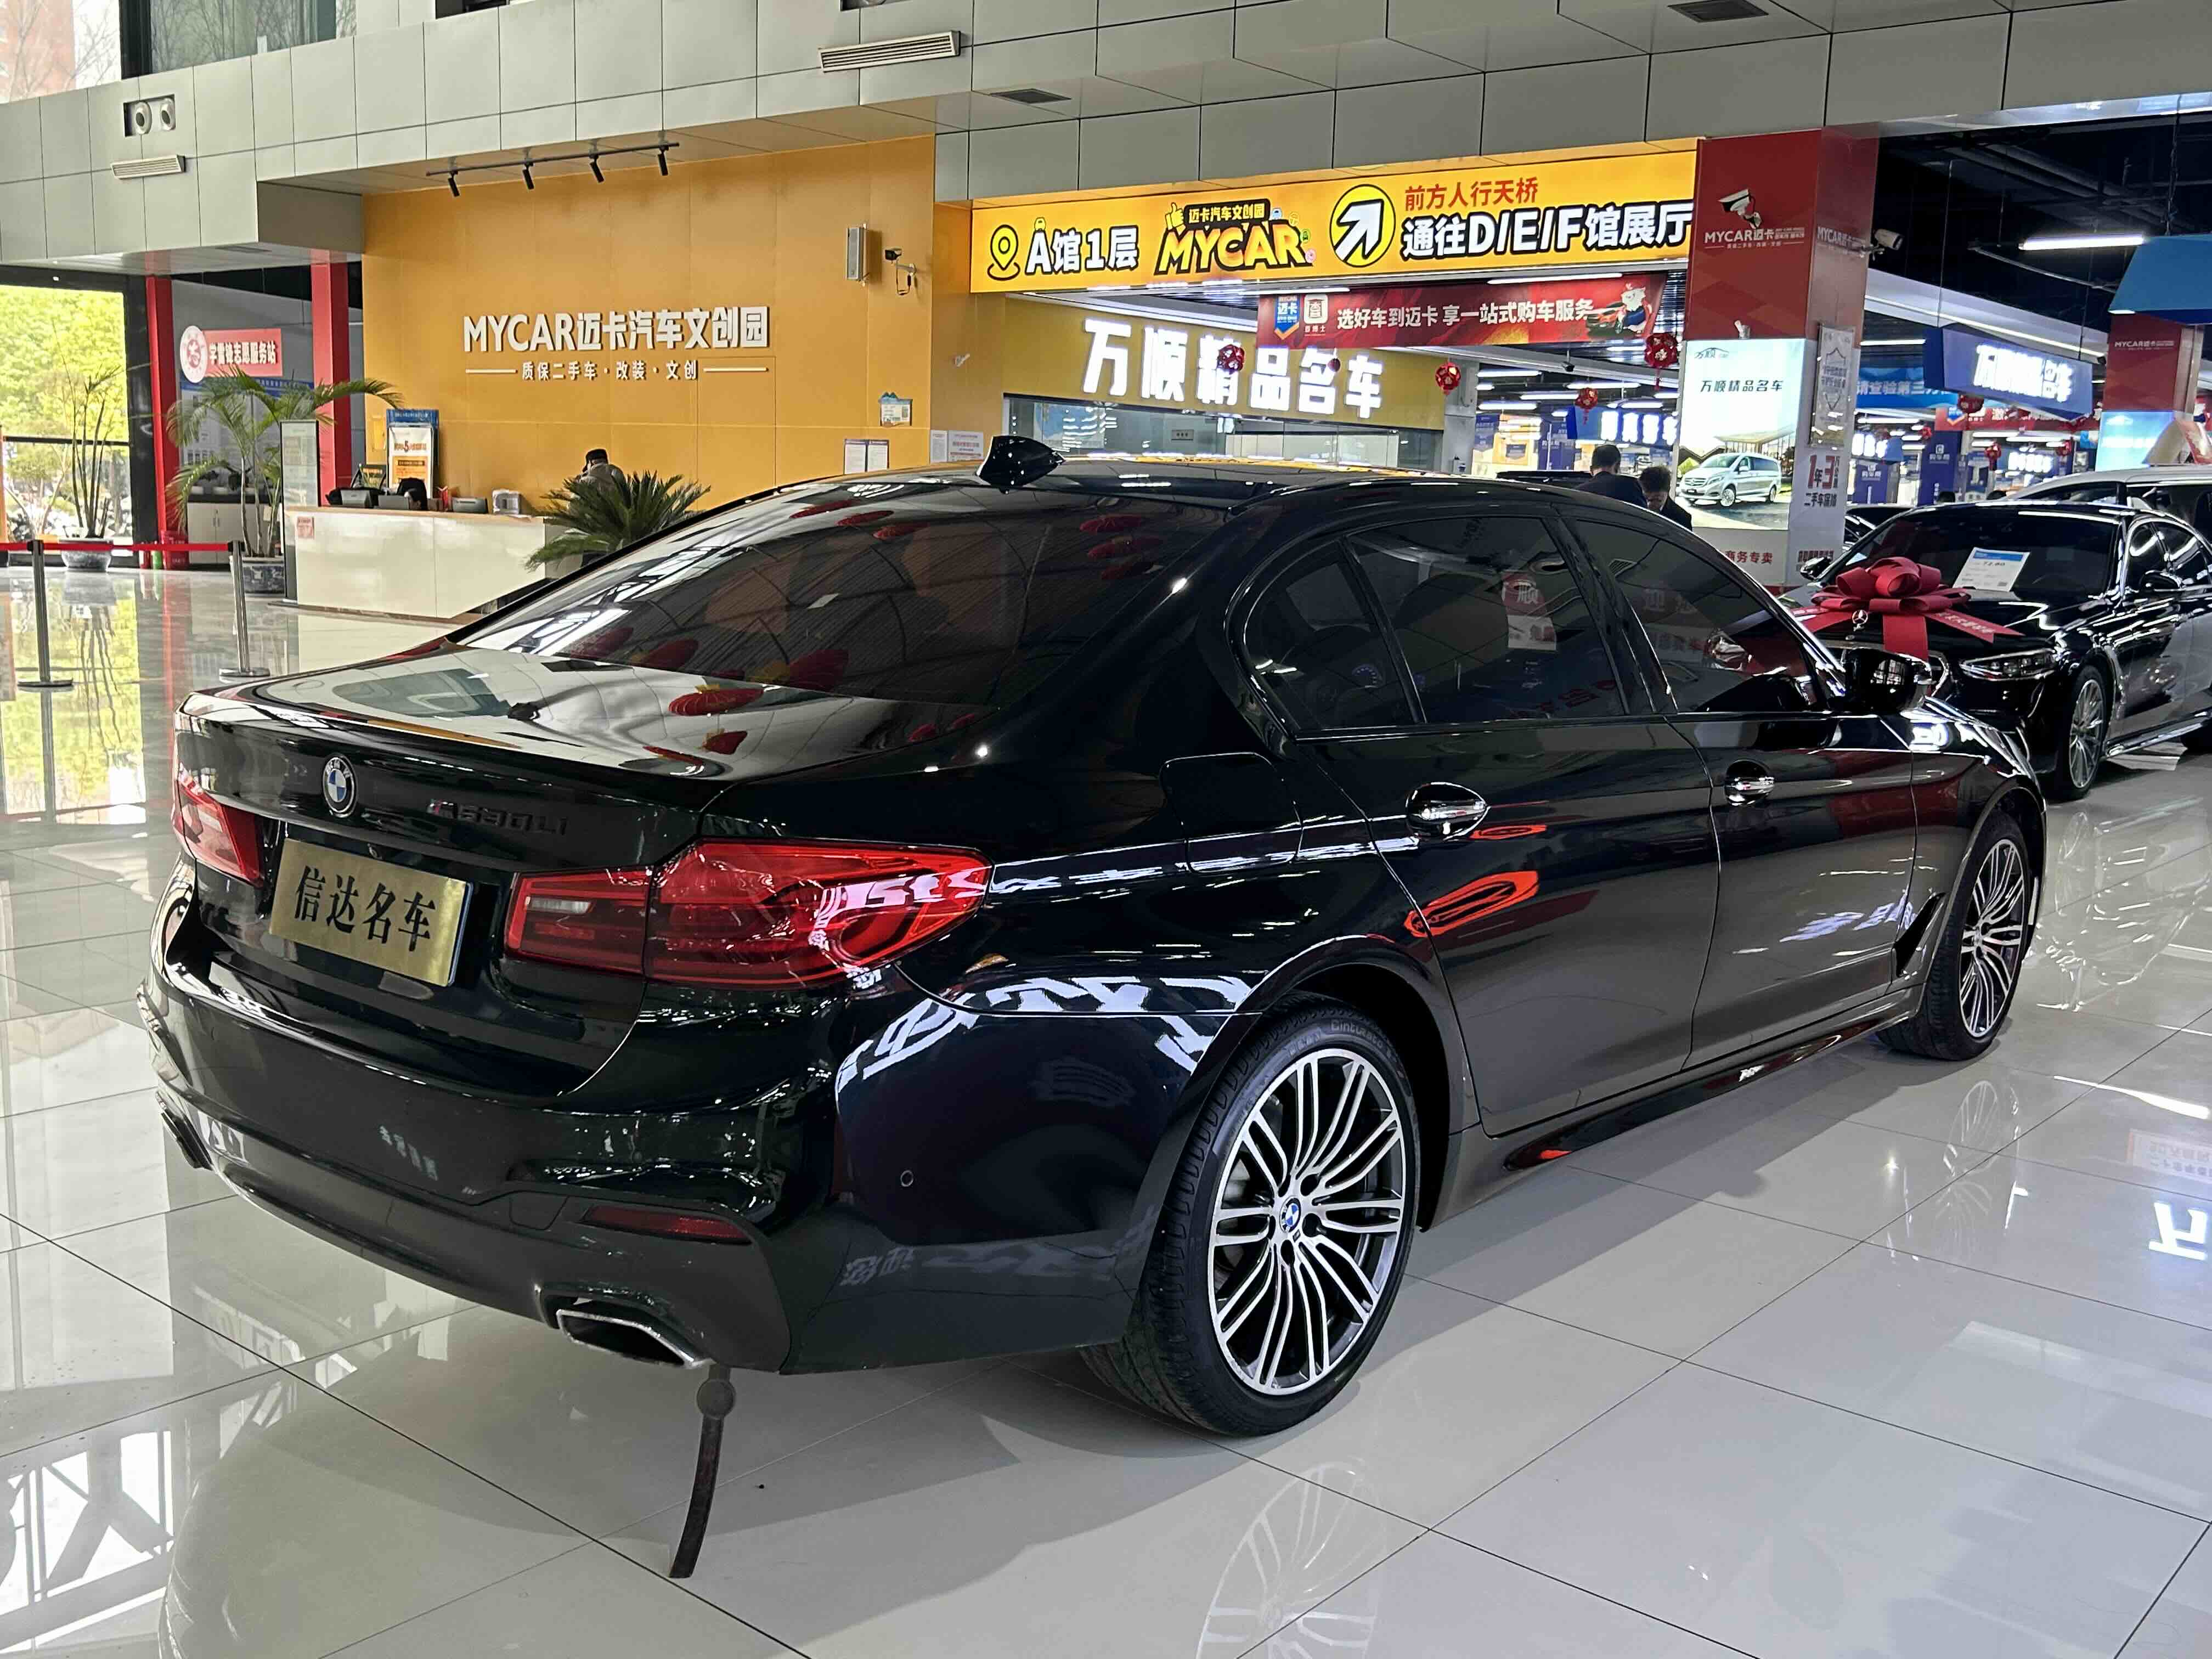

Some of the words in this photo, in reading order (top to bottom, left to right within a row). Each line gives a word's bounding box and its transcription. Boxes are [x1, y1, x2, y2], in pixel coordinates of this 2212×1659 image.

[1188, 202, 1265, 223] 迈卡汽车文创园
[1404, 177, 1538, 211] 前方人行天桥
[1026, 225, 1139, 274] A馆1层
[1157, 223, 1309, 273] MYCAR
[1402, 201, 1693, 259] 通往D/E/F馆展厅
[1277, 302, 1299, 315] 迈卡
[1337, 305, 1441, 330] 选好车到迈卡
[1442, 298, 1594, 327] 享一站式购车服务
[464, 306, 769, 352] MYCAR迈卡汽车文创园
[209, 341, 278, 364] 学雷锋志愿服务站
[1082, 318, 1383, 418] 万顺精品名车
[1700, 380, 1784, 392] 万顺精品名车
[293, 865, 436, 952] 信达名车
